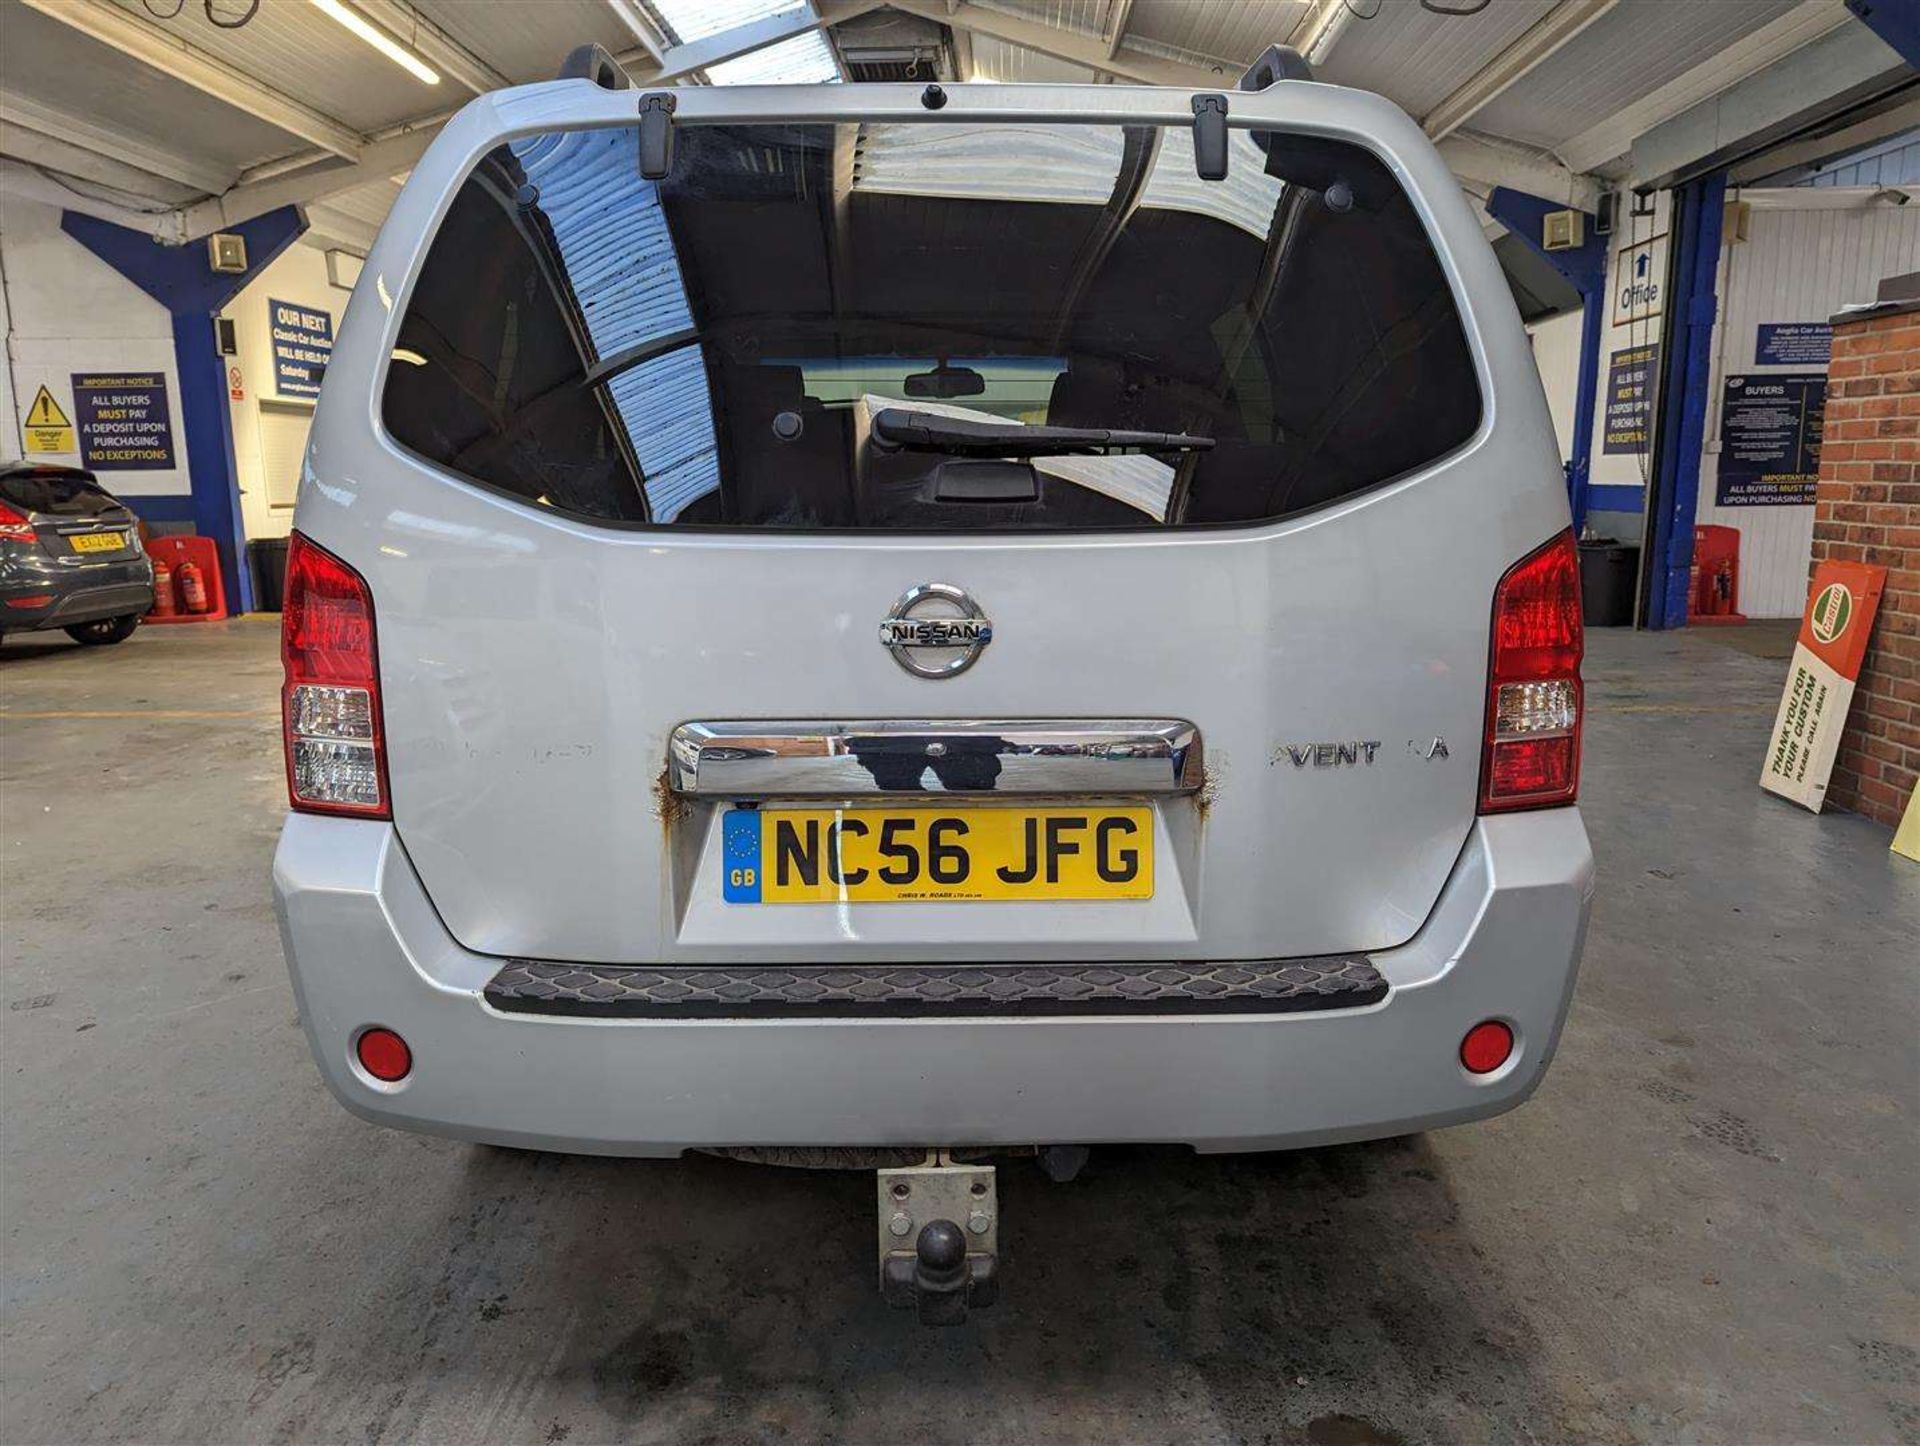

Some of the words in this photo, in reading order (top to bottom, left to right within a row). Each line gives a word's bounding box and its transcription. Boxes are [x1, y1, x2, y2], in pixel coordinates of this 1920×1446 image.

[1621, 284, 1658, 309] Office
[277, 307, 300, 327] OUR
[301, 313, 326, 332] NEXT
[276, 346, 294, 360] WILL
[294, 349, 304, 361] BE
[304, 351, 321, 364] HELD
[280, 364, 309, 381] Saturday
[1745, 386, 1785, 395] BUYERS
[91, 396, 110, 406] ALL
[112, 395, 150, 406] BUYERS
[97, 409, 127, 419] MUST
[128, 409, 147, 419] PAY
[83, 424, 91, 433] A
[92, 423, 135, 433] DEPOSIT
[136, 423, 166, 432] UPON
[92, 436, 159, 447] PURCHASING
[89, 450, 105, 460] NO
[106, 449, 168, 460] EXCEPTIONS
[1761, 474, 1804, 482] IMPORTANT
[1729, 485, 1744, 493] ALL
[1746, 485, 1778, 493] BUYERS
[1780, 484, 1802, 492] MUST
[1723, 496, 1748, 504] UPON
[1749, 494, 1802, 504] PURCHASING
[1823, 586, 1841, 635] Castrol
[891, 624, 980, 640] NISSAN
[1772, 726, 1791, 775] THANK
[1784, 695, 1799, 727] YOU
[1793, 666, 1807, 697] FOR
[1782, 740, 1799, 780] YOUR
[1793, 674, 1817, 738] CUSTOM
[1796, 747, 1811, 783] PLEASE
[1807, 720, 1819, 744] CALL
[1814, 684, 1828, 717] AGAIN
[1286, 741, 1382, 767] VENT
[776, 818, 970, 886] NC56
[996, 816, 1139, 884] JFG
[730, 868, 756, 887] GB
